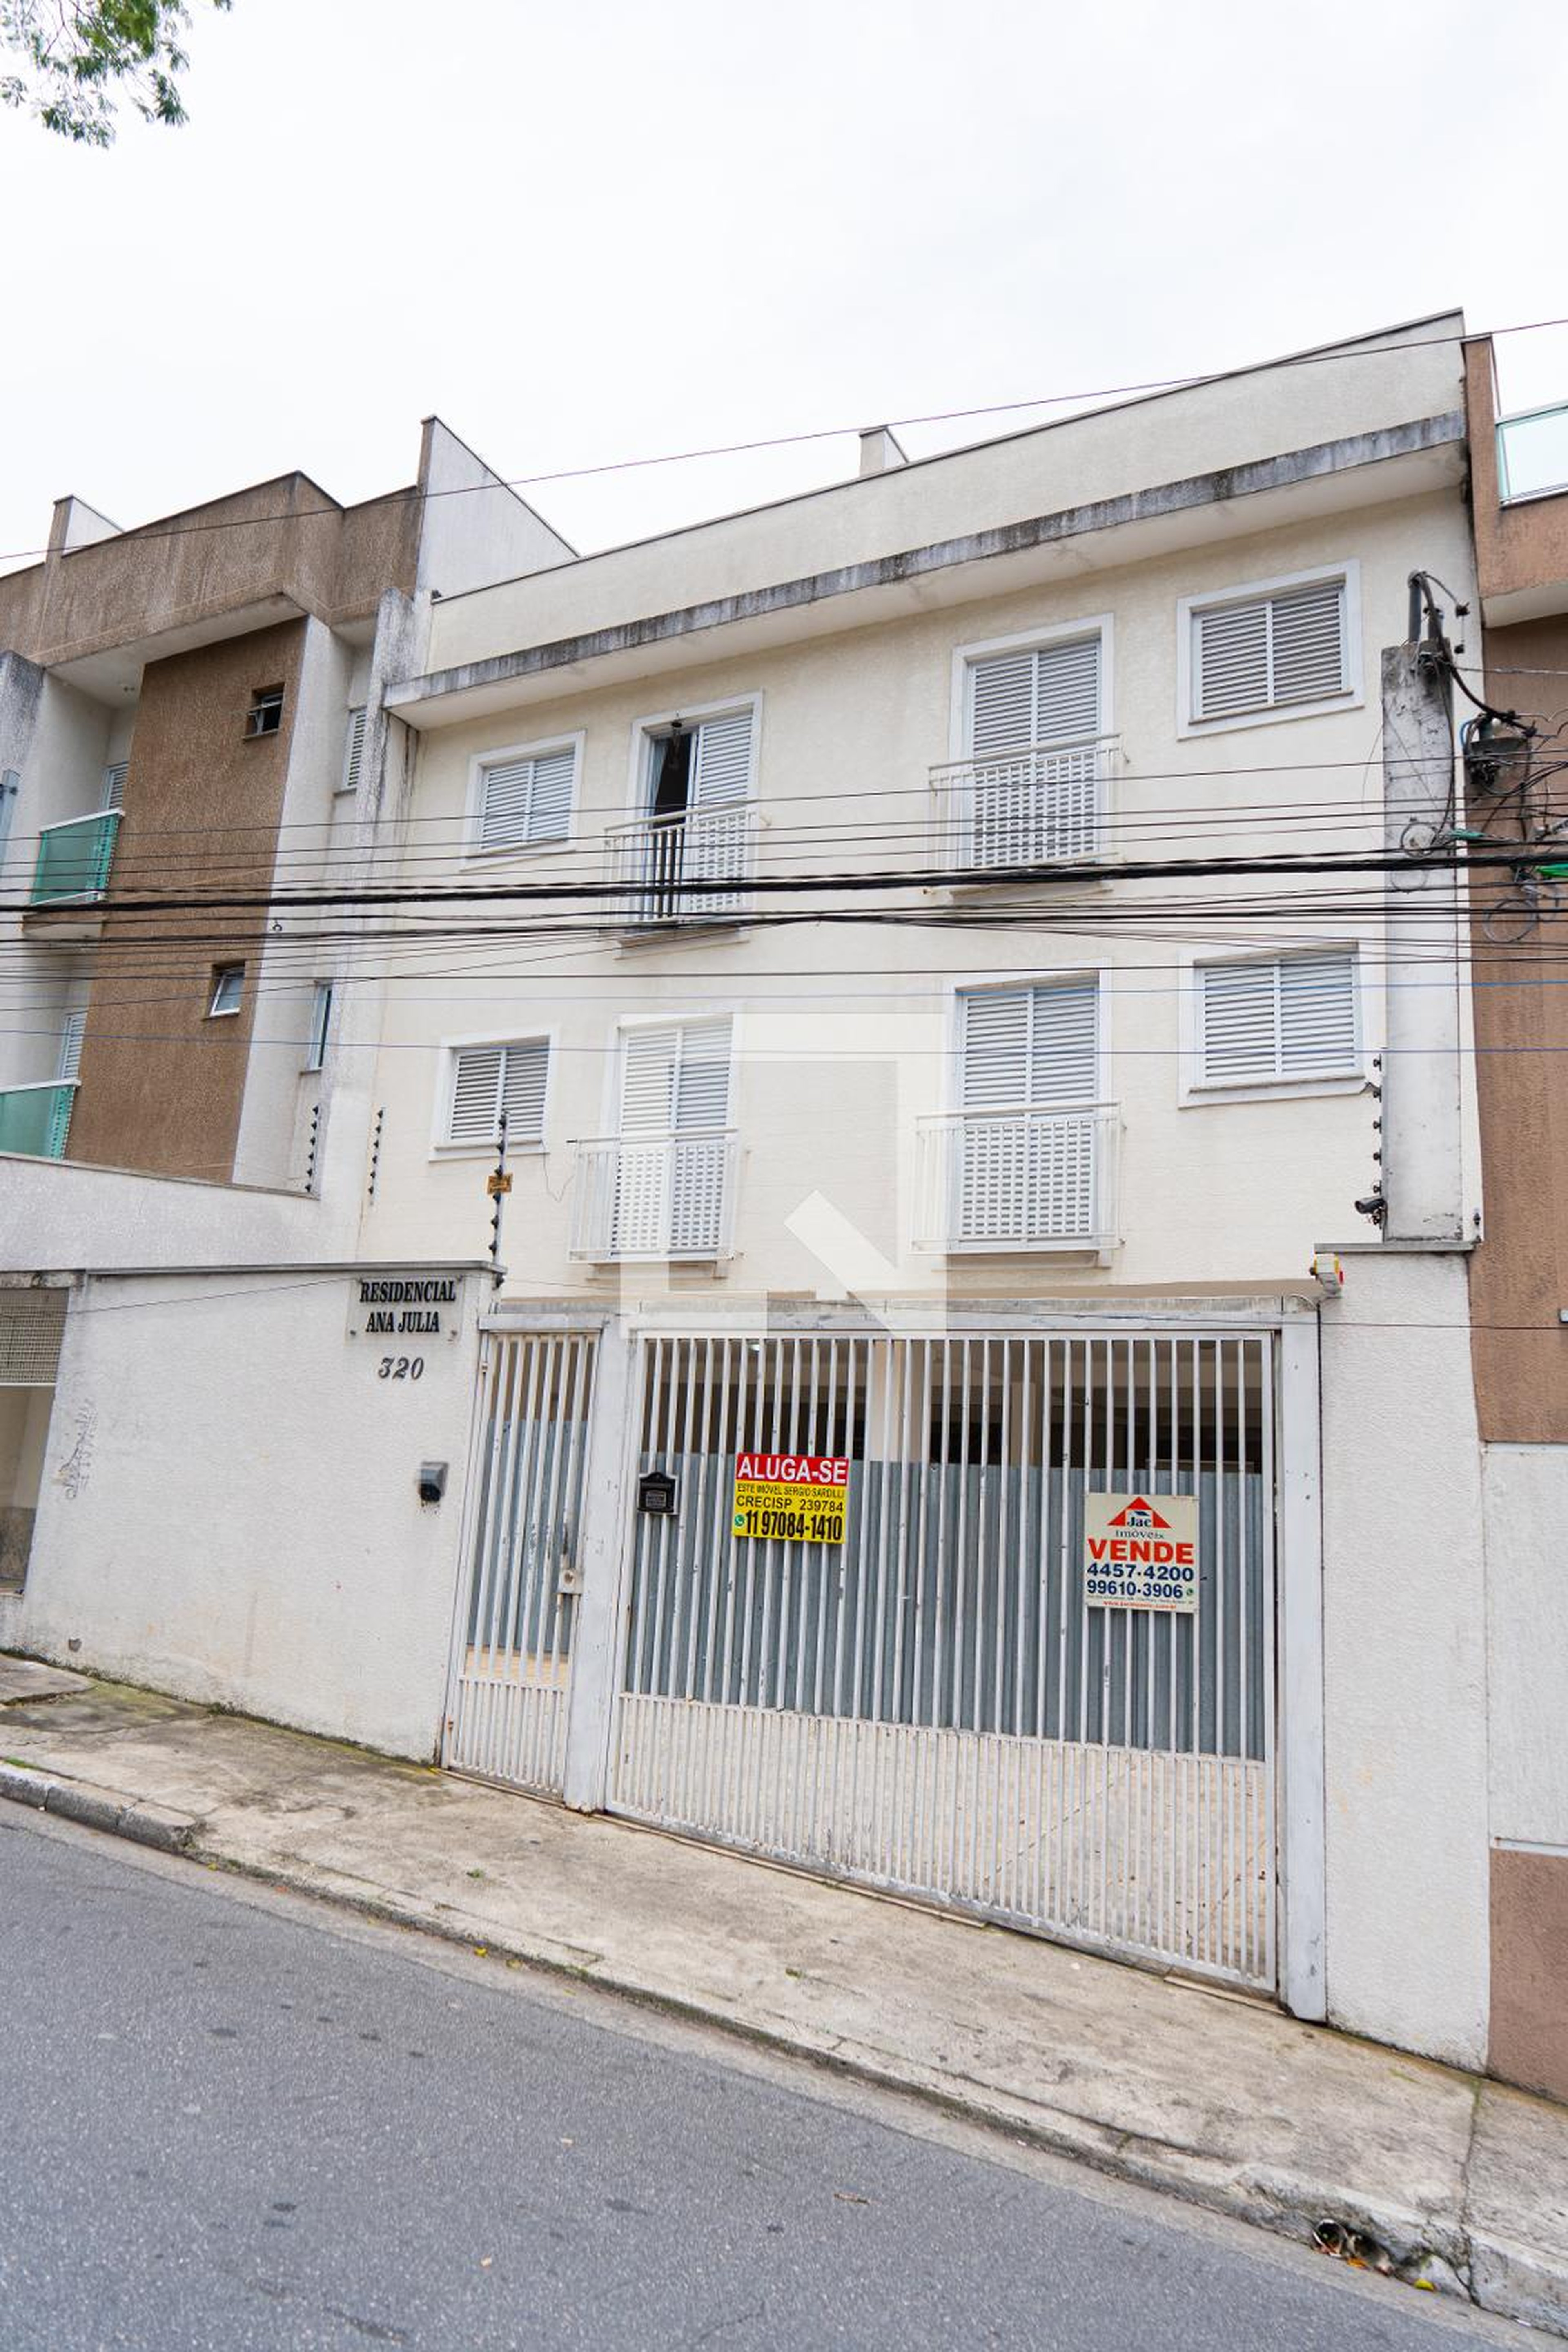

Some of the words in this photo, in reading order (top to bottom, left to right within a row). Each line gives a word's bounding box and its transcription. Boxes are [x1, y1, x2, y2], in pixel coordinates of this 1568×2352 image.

[359, 1281, 456, 1302] RESIDENCIAL
[365, 1312, 394, 1332] ANA
[398, 1311, 439, 1333] JULIA
[378, 1357, 424, 1380] 320
[738, 1456, 846, 1484] ALUGA-SE
[738, 1483, 755, 1494] ESTE
[736, 1495, 792, 1509] CRECISP
[799, 1499, 843, 1512] 239784
[746, 1510, 758, 1535] 11
[761, 1511, 843, 1541] 97084-1410
[1127, 1517, 1152, 1527] Jac
[1088, 1539, 1194, 1564] VENDE
